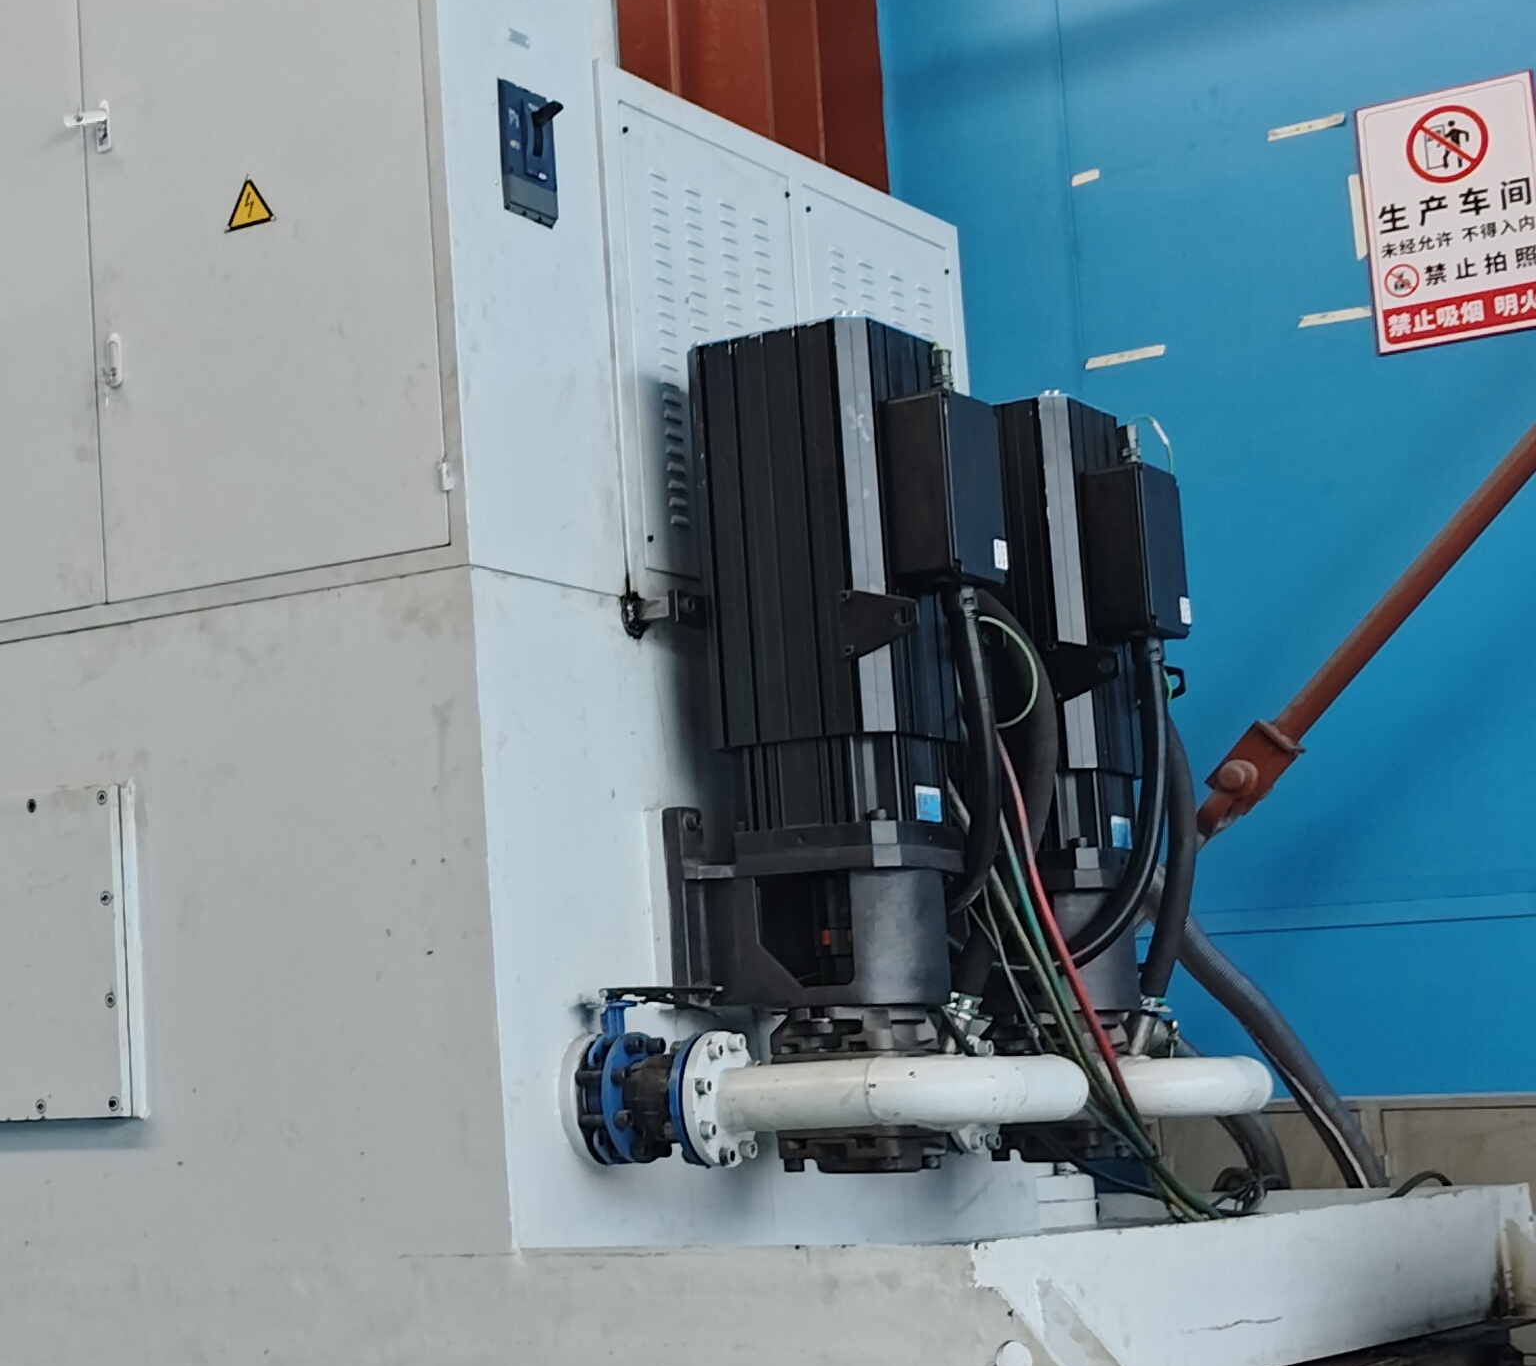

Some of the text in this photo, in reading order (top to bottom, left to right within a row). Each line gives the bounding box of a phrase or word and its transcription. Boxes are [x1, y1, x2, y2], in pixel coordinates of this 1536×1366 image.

[1378, 176, 1532, 235] 生产车间
[1381, 214, 1536, 259] 未经允许 不得入内
[1423, 245, 1536, 287] 禁止拍照
[1387, 299, 1485, 339] 禁止吸烟
